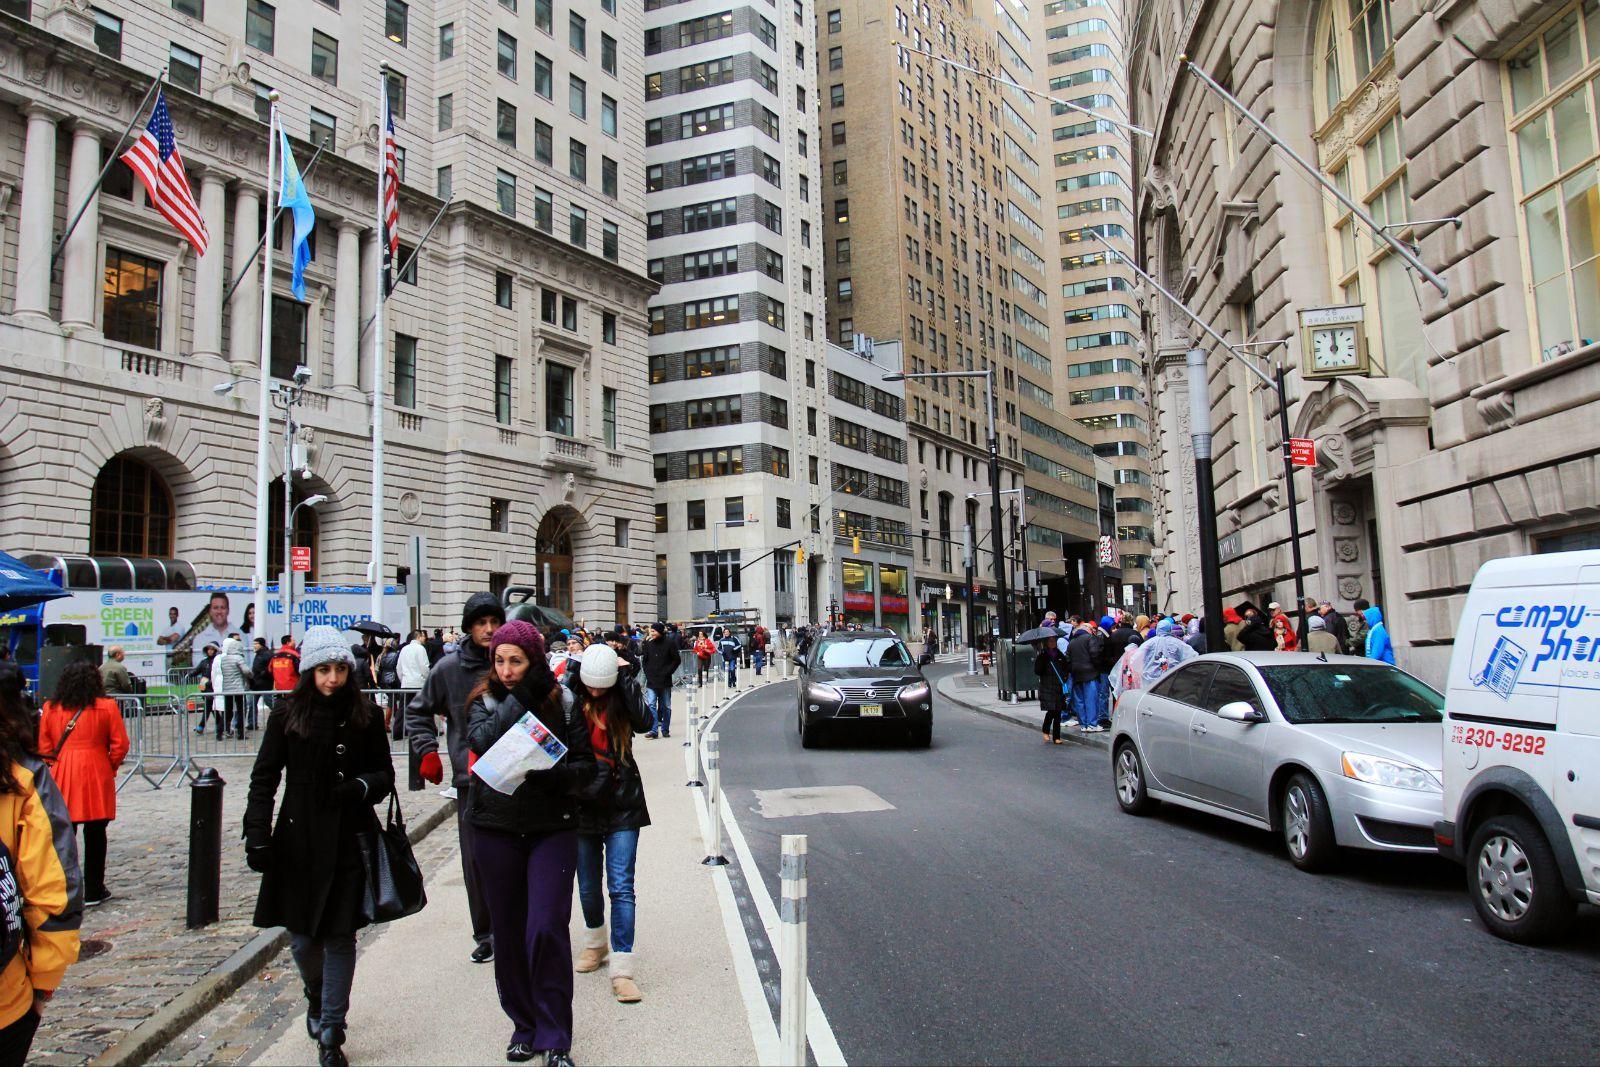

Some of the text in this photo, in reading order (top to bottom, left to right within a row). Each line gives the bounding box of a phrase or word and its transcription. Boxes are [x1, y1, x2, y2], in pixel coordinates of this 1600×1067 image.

[1308, 315, 1355, 323] BROADWAY
[298, 599, 328, 614] YORK
[100, 607, 153, 621] GREEN
[305, 614, 357, 632] ENERGY
[1451, 735, 1463, 744] 212
[1465, 727, 1546, 755] 230-9292
